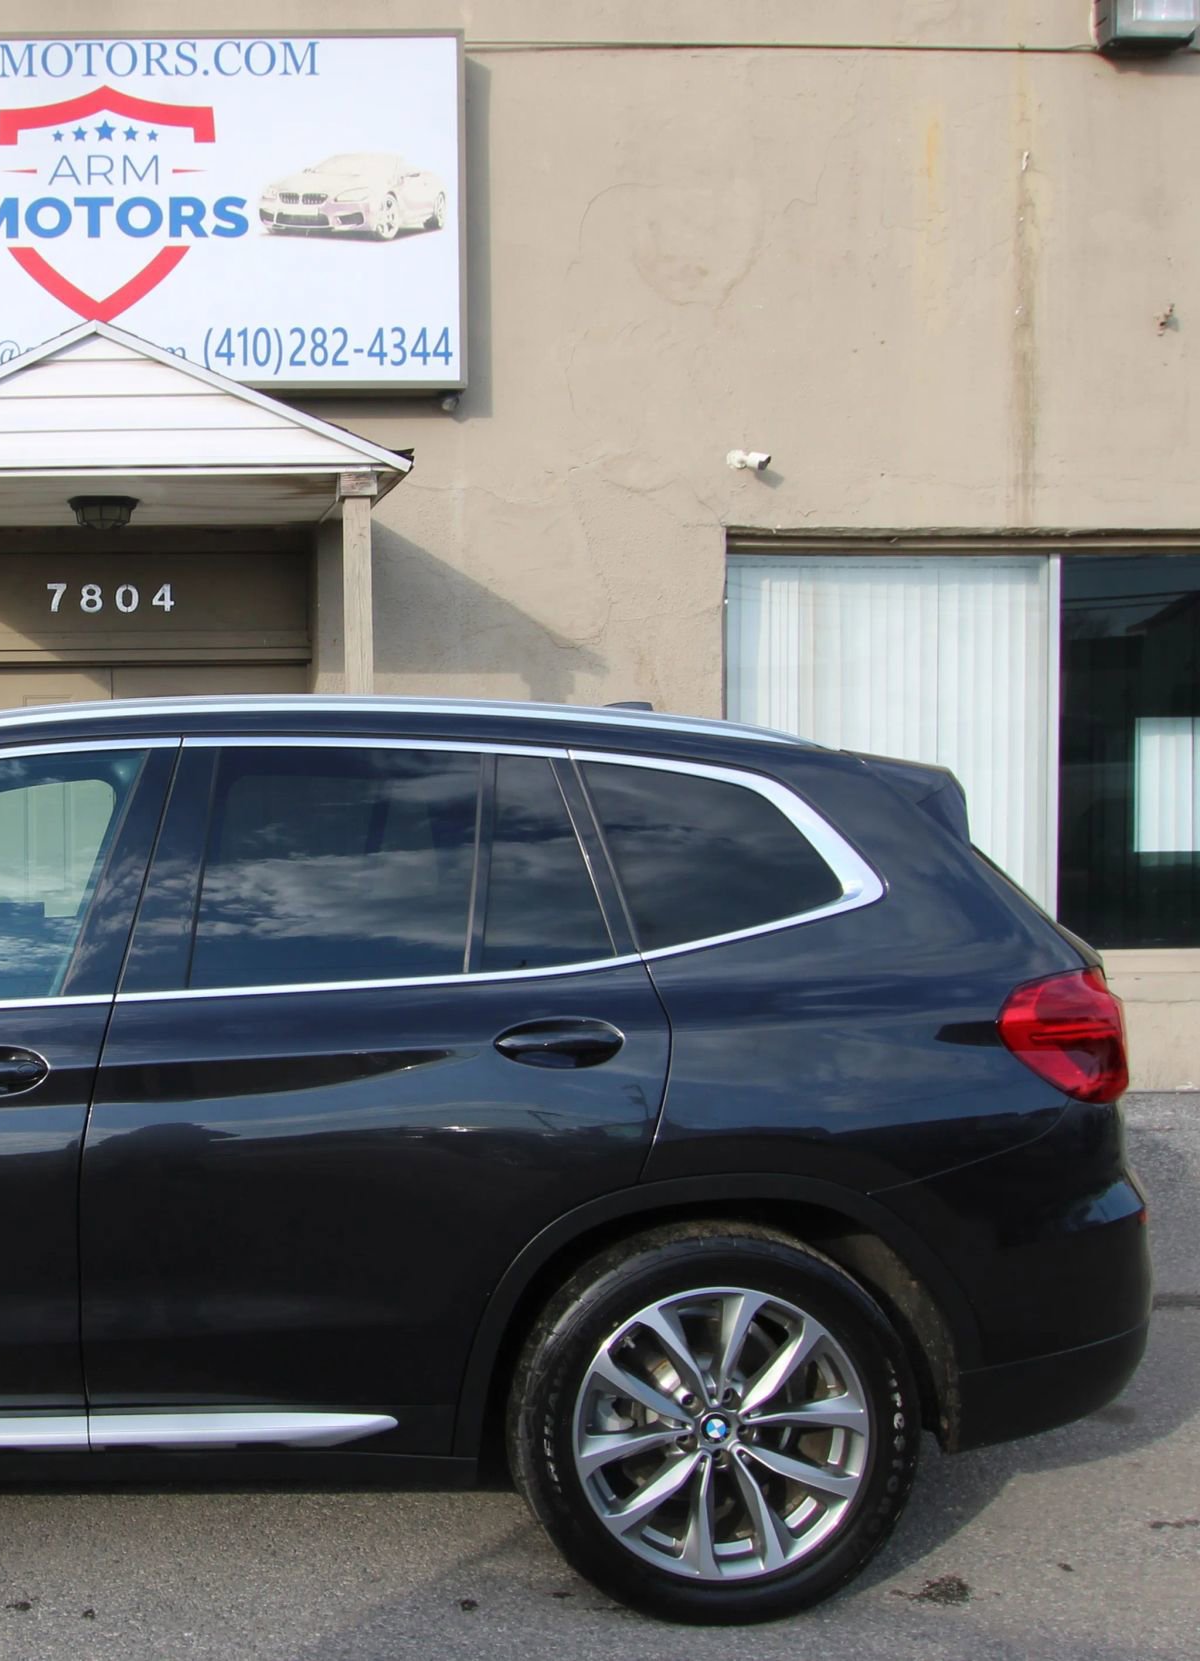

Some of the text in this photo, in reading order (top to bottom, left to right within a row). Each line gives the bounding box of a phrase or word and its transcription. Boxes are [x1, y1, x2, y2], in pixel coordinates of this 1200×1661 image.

[47, 154, 160, 187] ARM
[202, 325, 454, 376] (410)282-4344
[46, 583, 175, 613] 7804
